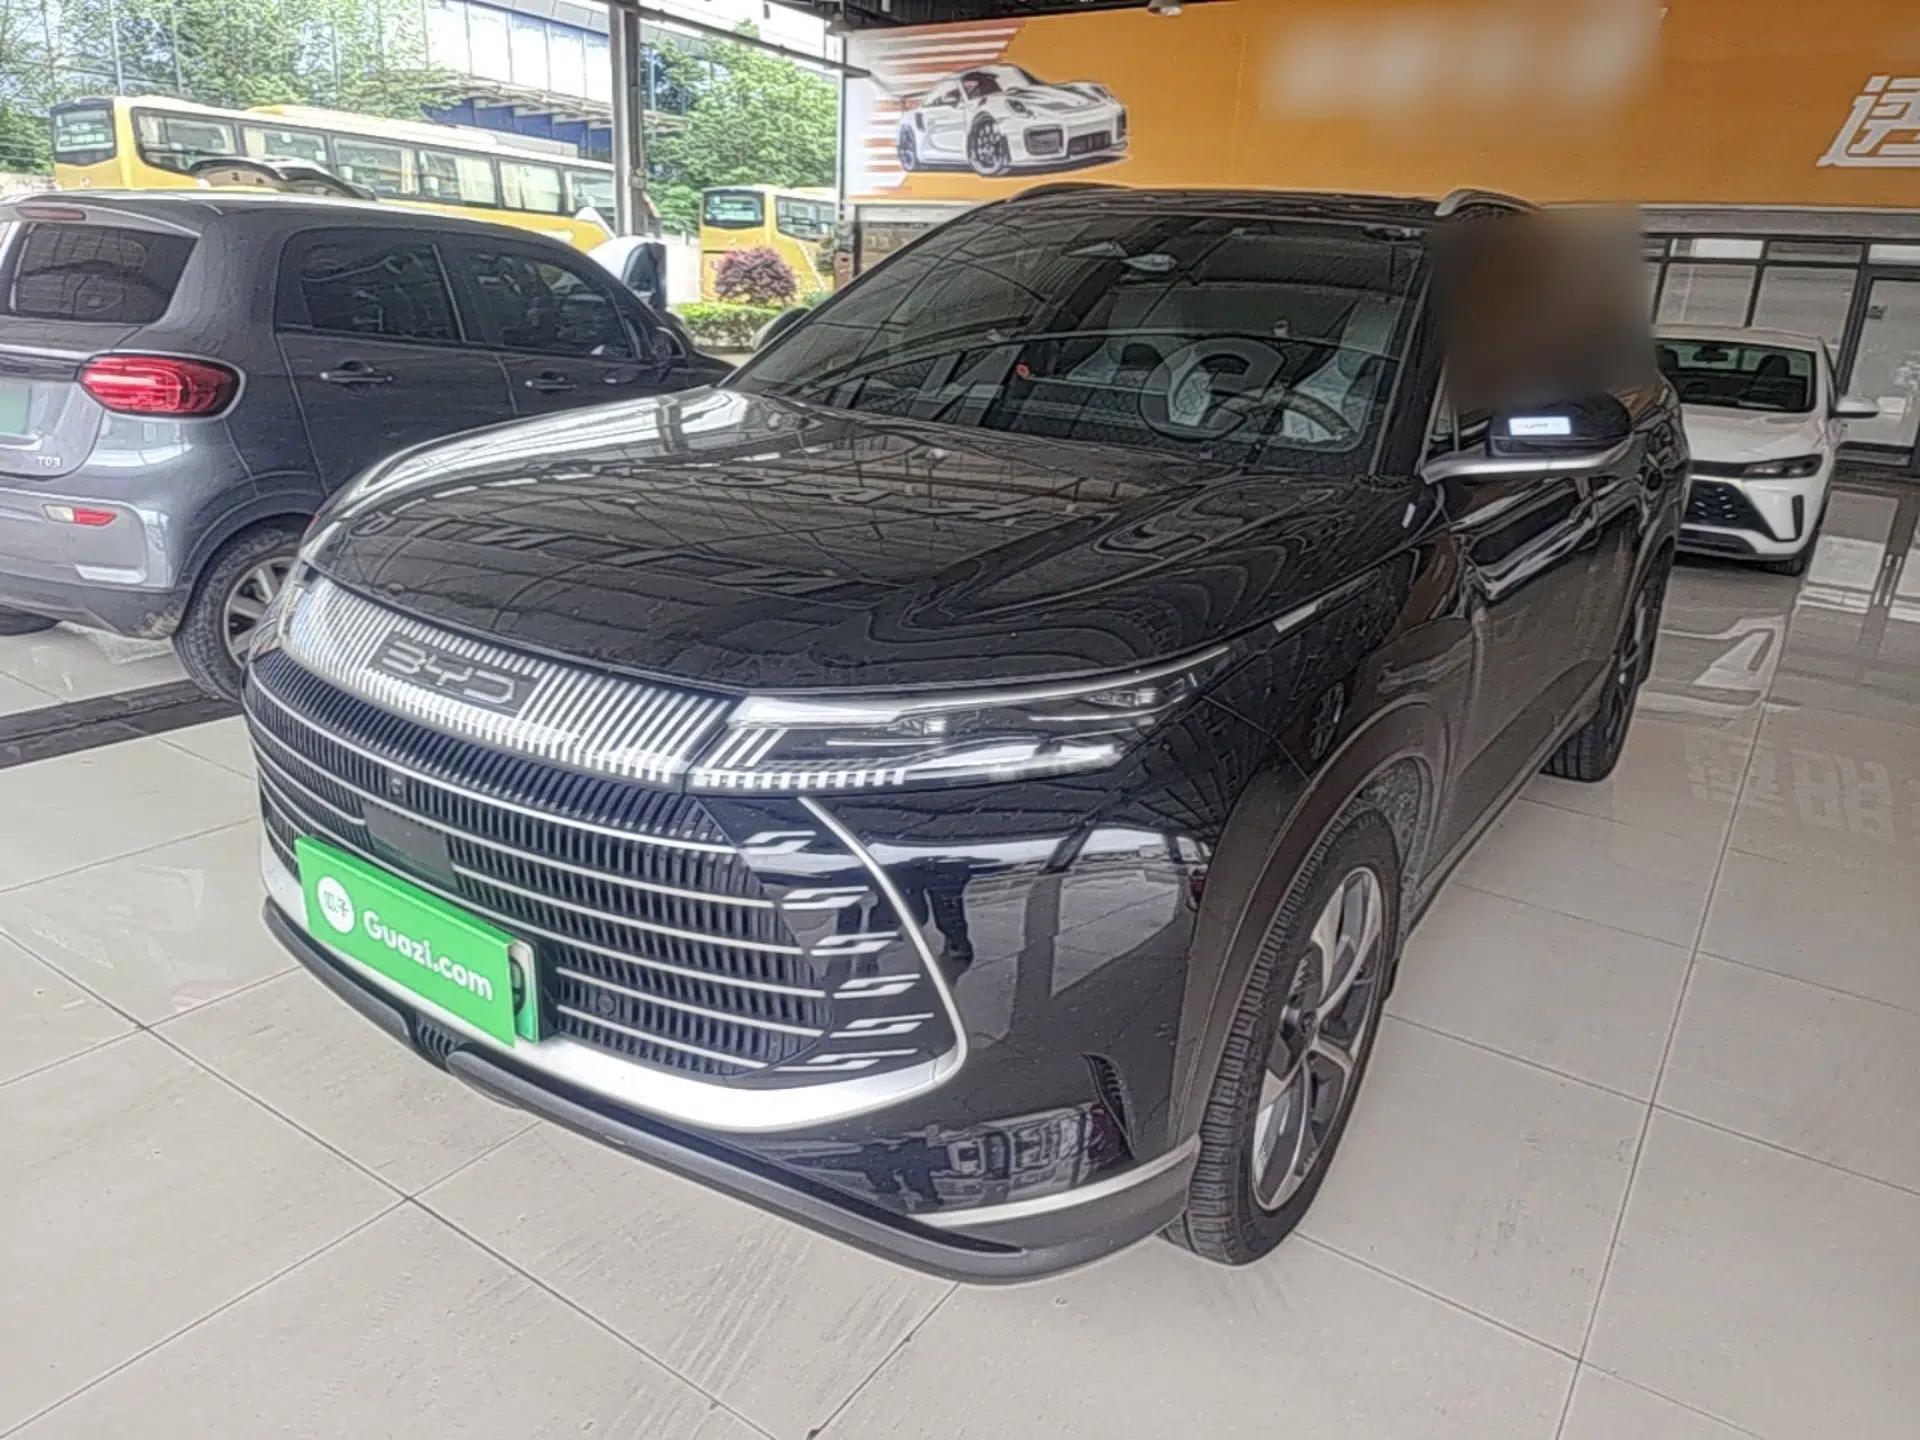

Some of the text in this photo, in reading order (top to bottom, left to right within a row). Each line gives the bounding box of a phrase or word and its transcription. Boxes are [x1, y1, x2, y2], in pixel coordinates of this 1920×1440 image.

[37, 456, 61, 468] T03
[382, 640, 515, 703] BYD
[363, 910, 493, 1001] Guazi.com
